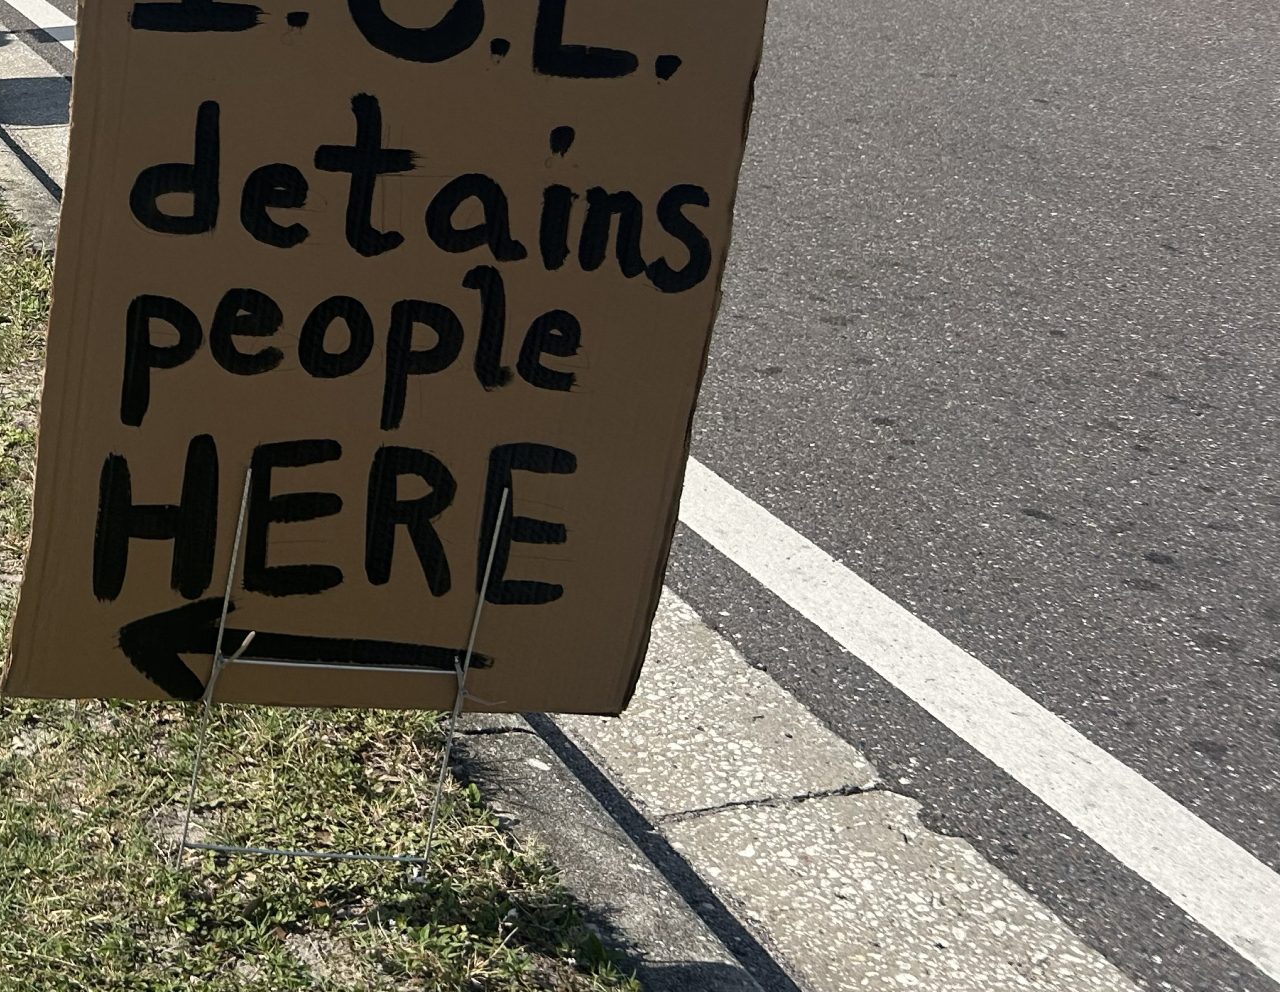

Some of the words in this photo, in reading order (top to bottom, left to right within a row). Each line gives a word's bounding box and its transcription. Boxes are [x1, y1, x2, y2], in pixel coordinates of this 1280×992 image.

[128, 92, 713, 294] detains
[119, 265, 584, 432] people
[92, 433, 578, 606] HERE
